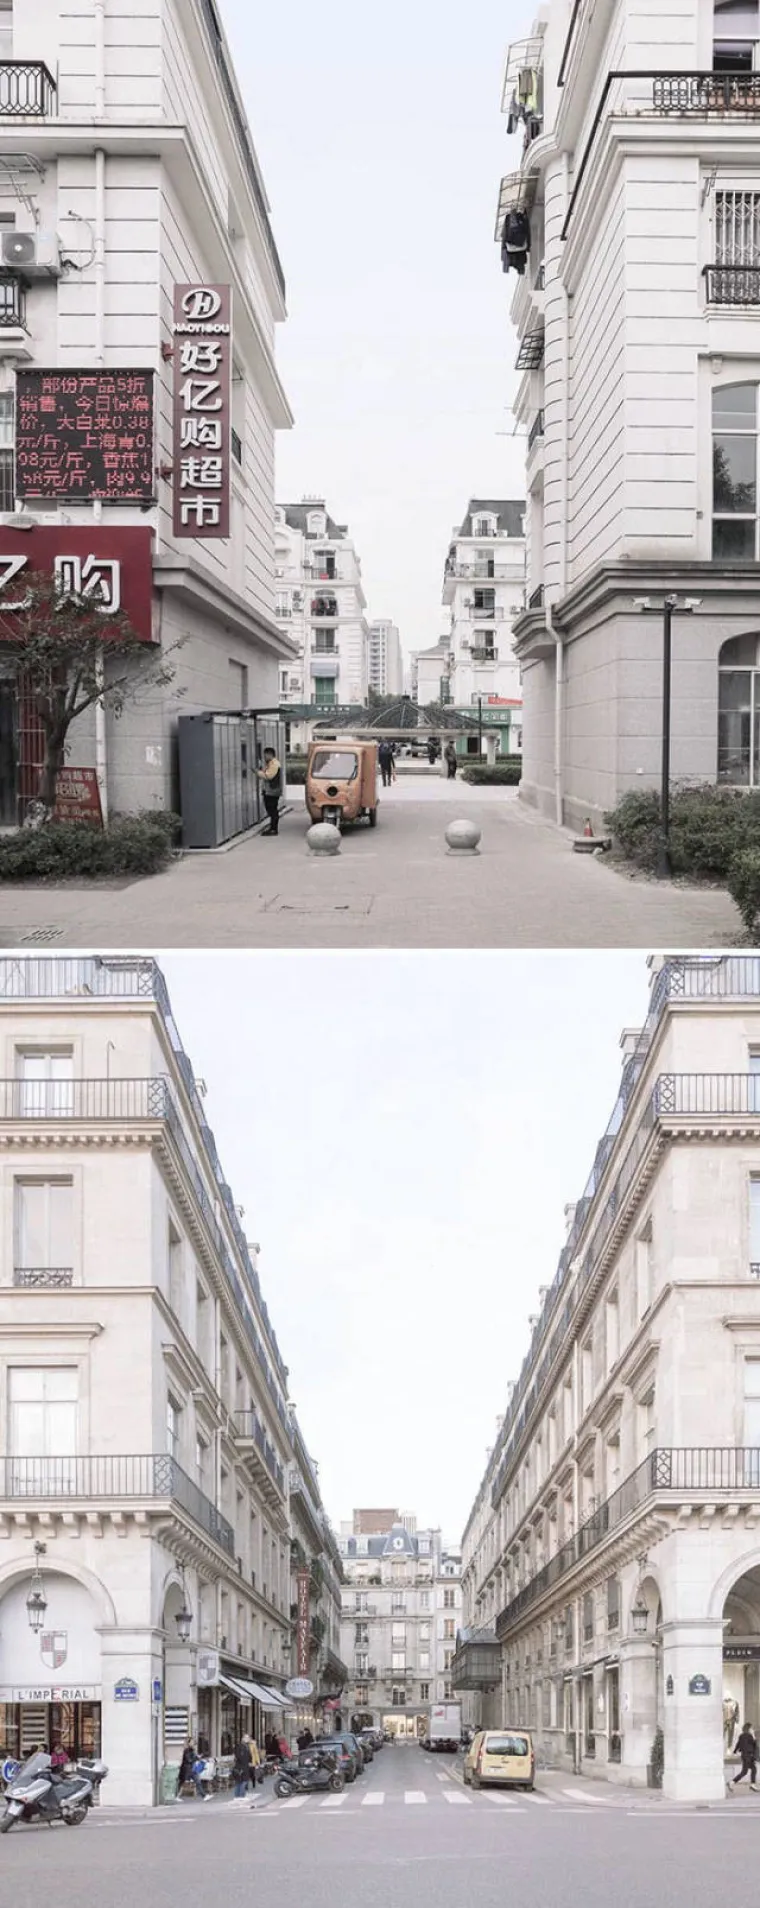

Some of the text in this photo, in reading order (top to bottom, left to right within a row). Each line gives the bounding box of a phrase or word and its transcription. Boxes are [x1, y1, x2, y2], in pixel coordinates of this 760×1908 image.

[178, 340, 223, 526] 好亿购超市
[18, 1688, 89, 1700] L'IMPERIAL
